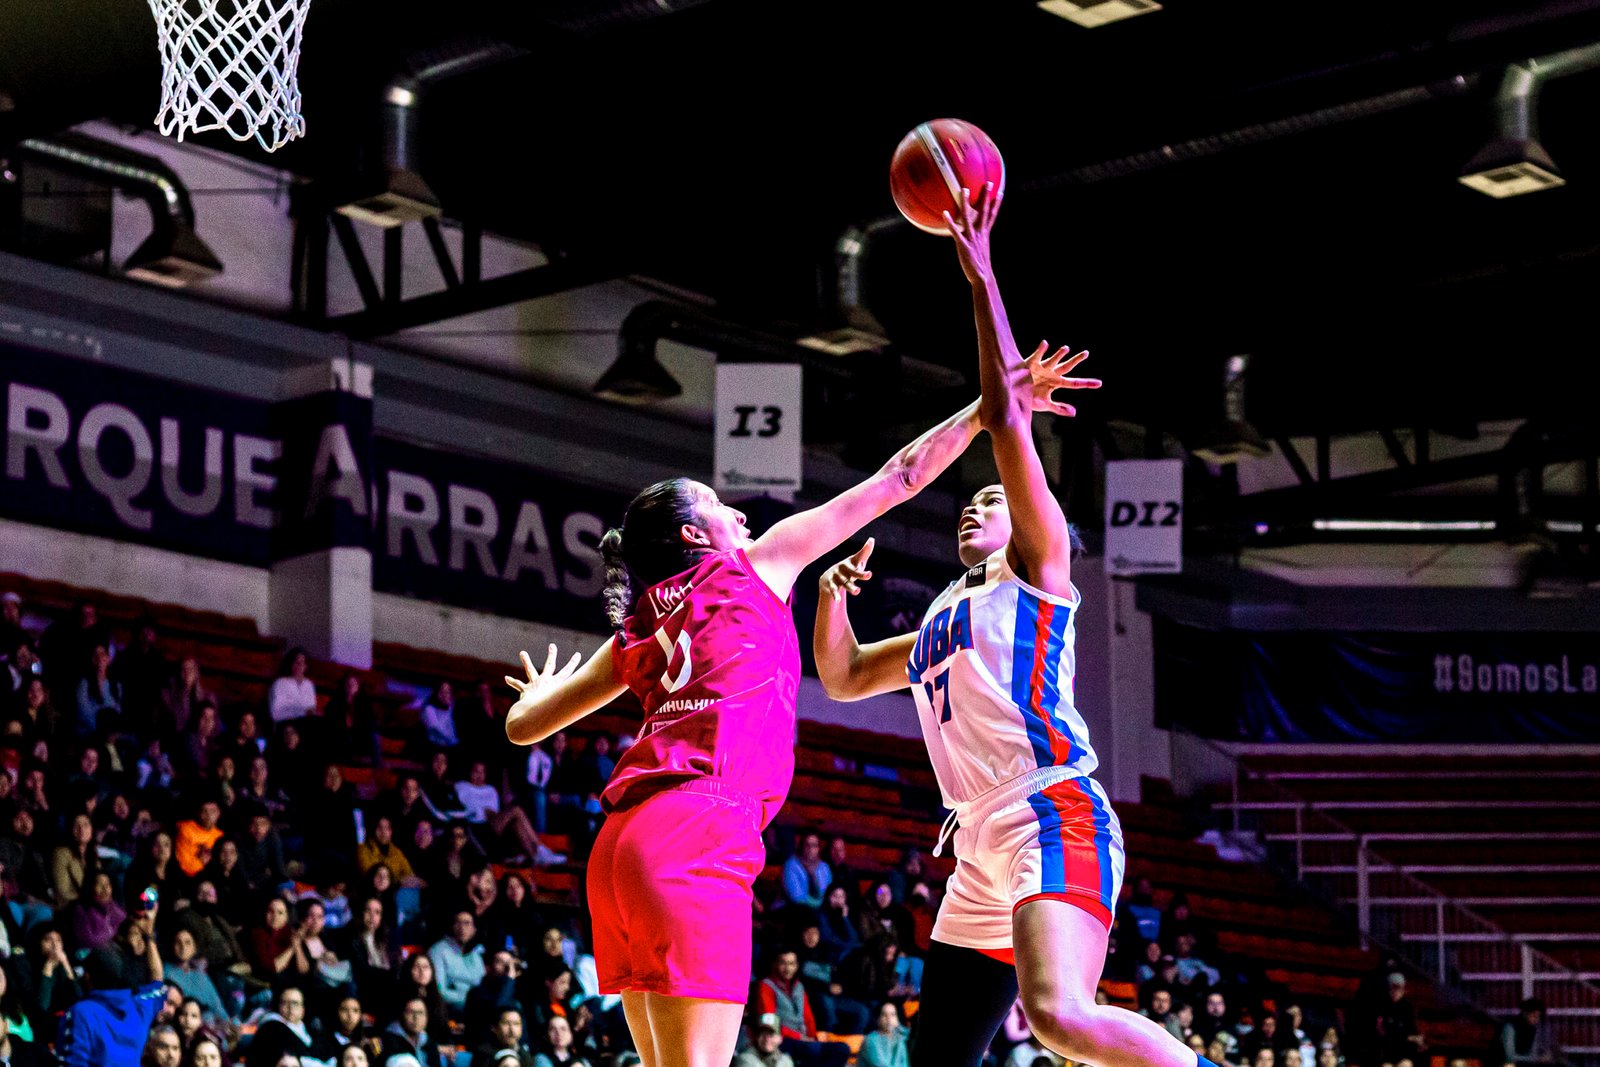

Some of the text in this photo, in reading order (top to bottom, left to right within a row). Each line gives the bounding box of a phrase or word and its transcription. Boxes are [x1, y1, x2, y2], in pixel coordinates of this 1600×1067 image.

[729, 405, 782, 437] I3
[1110, 501, 1180, 527] DI2
[968, 566, 983, 577] FIBA
